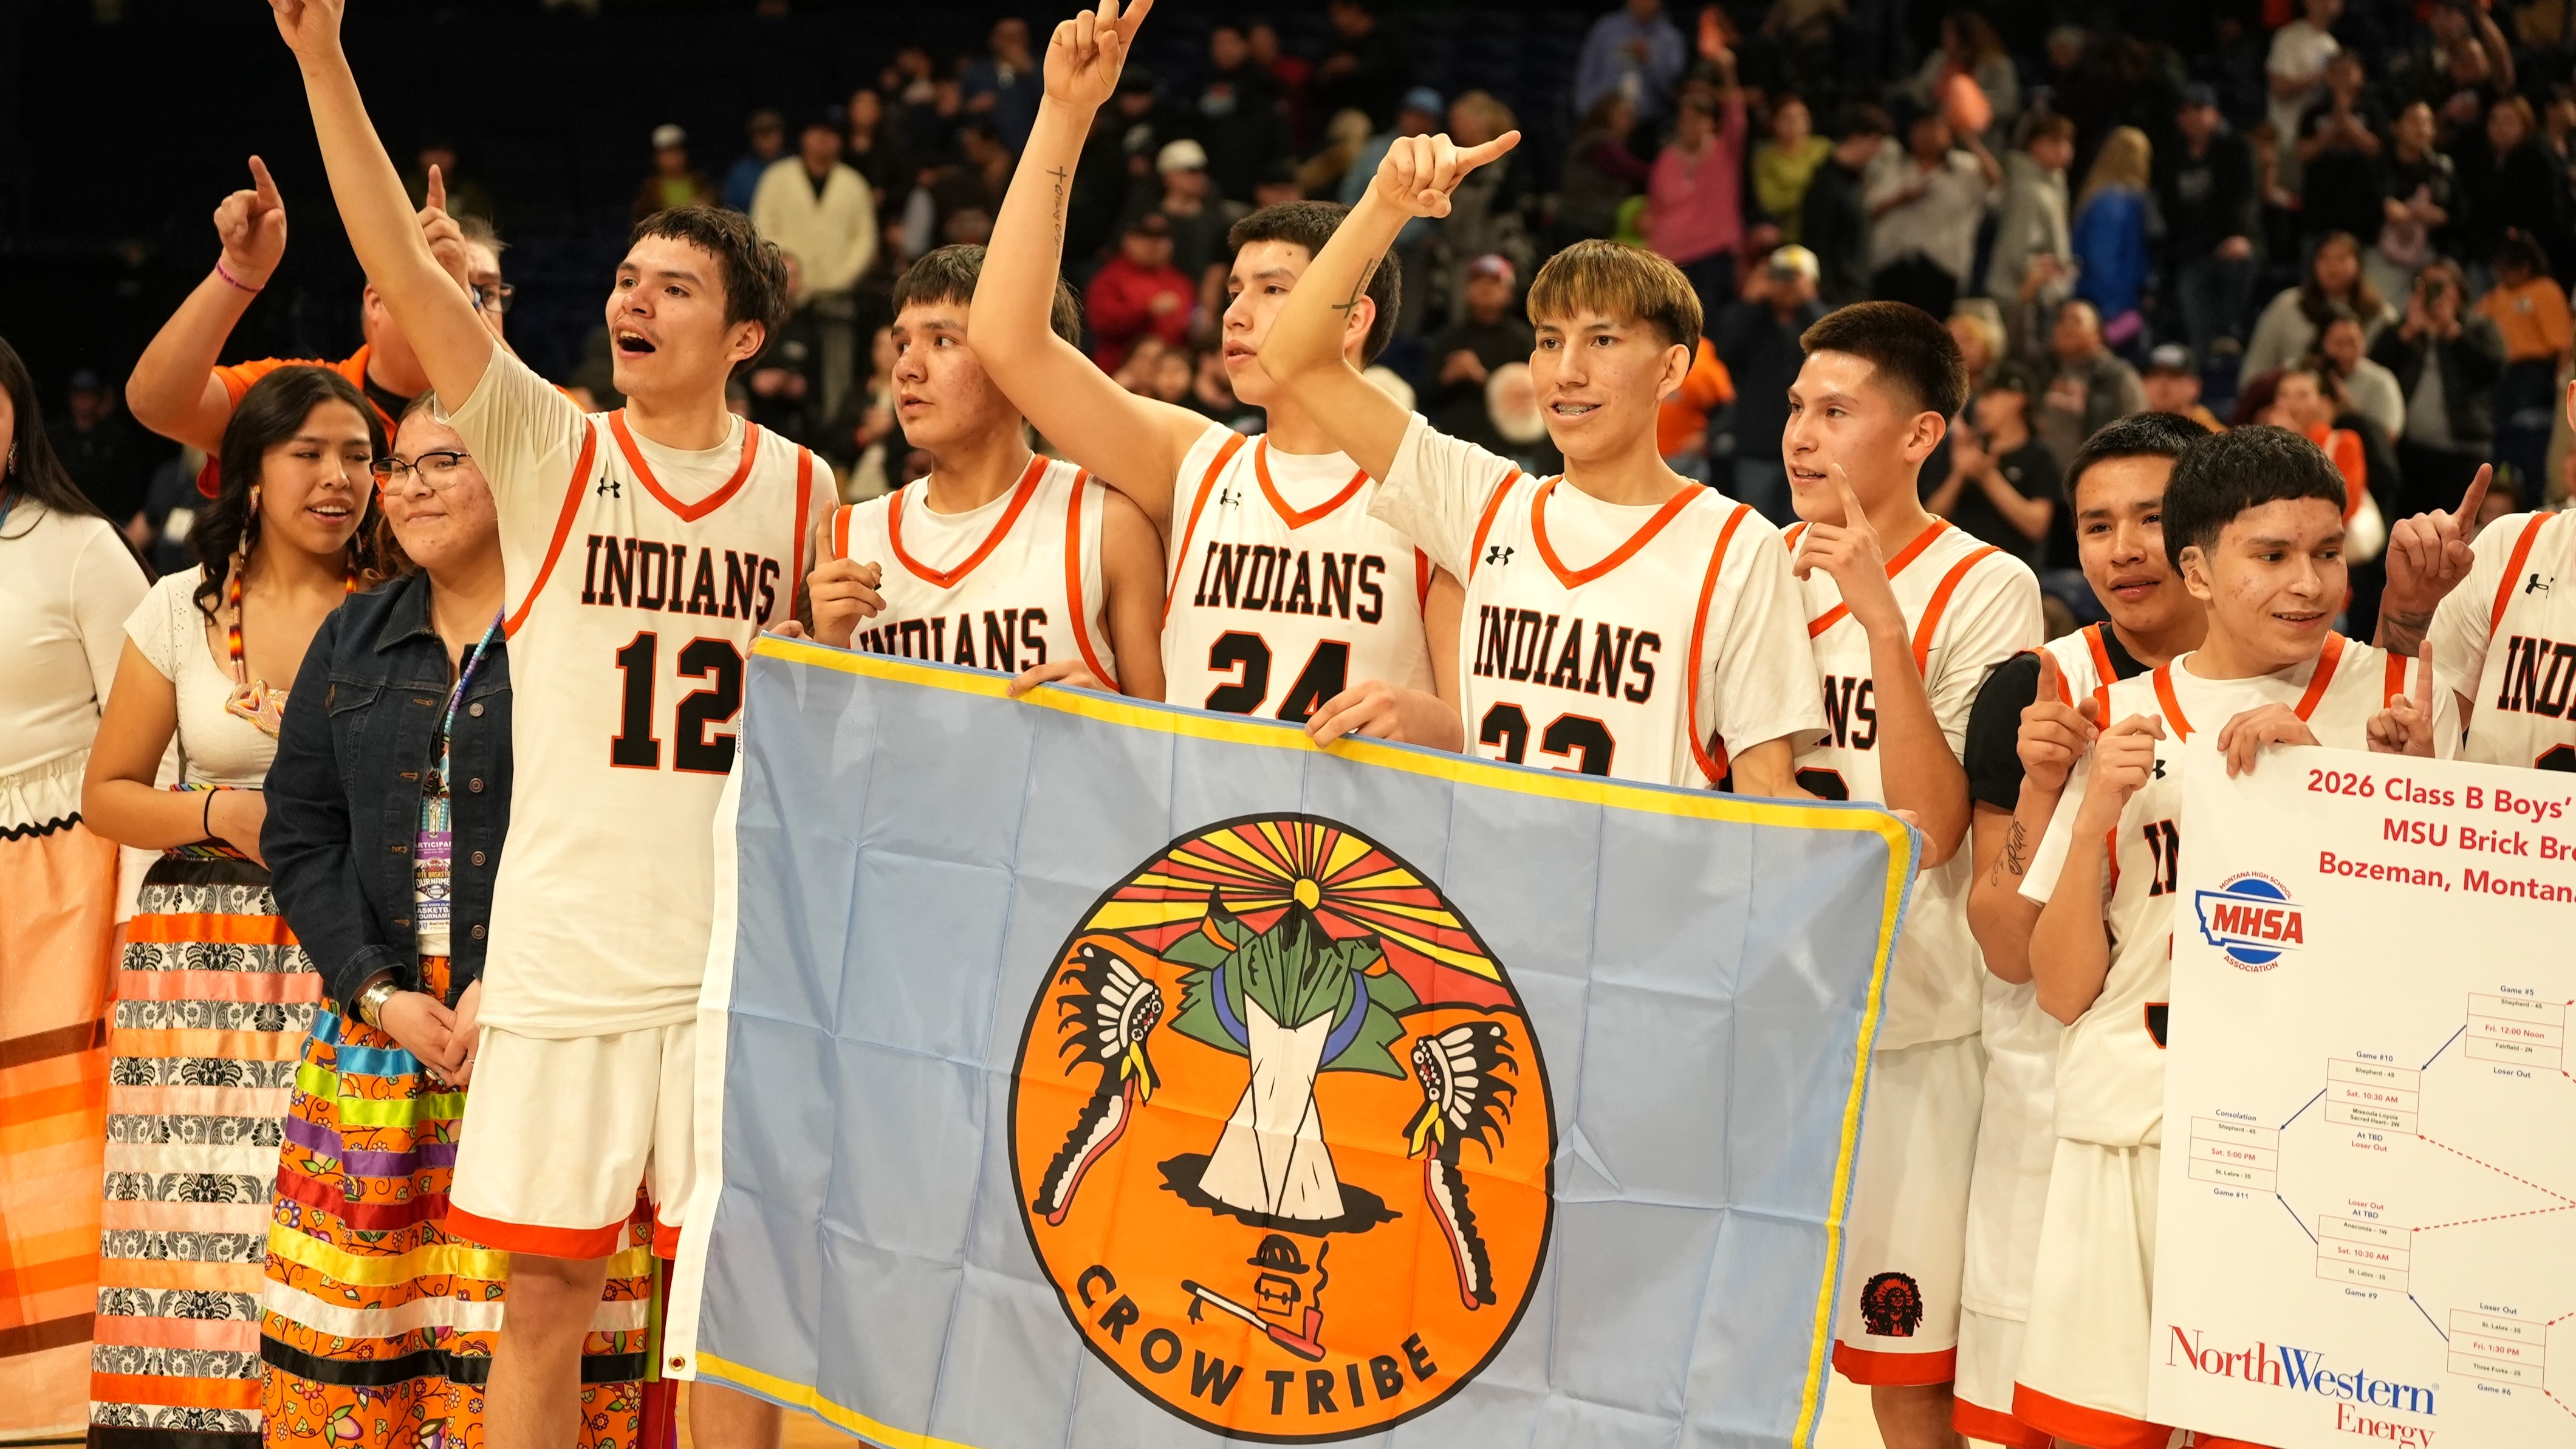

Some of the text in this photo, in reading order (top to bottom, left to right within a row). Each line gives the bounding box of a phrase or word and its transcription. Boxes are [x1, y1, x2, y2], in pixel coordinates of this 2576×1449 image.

[581, 533, 780, 626] INDIANS
[1193, 540, 1386, 625] INDIANS
[1473, 604, 1662, 705] INDIANS
[1205, 629, 1351, 723] 24
[610, 631, 744, 775] 12
[2308, 769, 2374, 797] 2026
[2385, 778, 2454, 806] Class
[2466, 786, 2484, 809] B
[2383, 818, 2448, 846] MSU
[2459, 826, 2529, 857] Brick
[2319, 851, 2576, 903] Bozeman, Montan
[2219, 871, 2292, 900] MONTANA HIGH SCHOOL
[2213, 903, 2303, 944] MHSA
[2224, 955, 2278, 973] ASSOCIATION
[2500, 985, 2522, 994] Game
[2501, 998, 2530, 1008] Shepherd
[2500, 1026, 2521, 1035] 12:00
[2523, 1029, 2544, 1039] Noon
[2356, 1050, 2377, 1060] Game
[2355, 1067, 2382, 1077] Shepherd
[2493, 1066, 2531, 1078] Loser Out
[2346, 1089, 2360, 1098] Sat.
[2363, 1092, 2383, 1101] 10:30
[2216, 1109, 2256, 1122] Consolation
[2350, 1114, 2369, 1123] Sacred
[2352, 1108, 2398, 1121] Missoula Loyola
[2218, 1123, 2244, 1132] Shepherd
[2368, 1133, 2383, 1142] TBD
[2352, 1140, 2387, 1152] Loser Out
[2211, 1148, 2225, 1156] Sat.
[2227, 1150, 2242, 1159] 5:00
[2224, 1170, 2239, 1178] Labre
[2213, 1188, 2234, 1197] Game
[2348, 1198, 2384, 1210] Loser Out
[2363, 1210, 2379, 1219] TBD
[2343, 1222, 2372, 1232] Anaconda
[2337, 1246, 2351, 1255] Sat.
[2354, 1249, 2374, 1259] 10:30
[2345, 1287, 2366, 1298] Game
[2480, 1302, 2518, 1315] Loser Out
[1076, 1264, 1437, 1416] CROW TRIBE
[2473, 1341, 2485, 1350] Fri.
[2489, 1345, 2505, 1354] 1:30
[2473, 1363, 2490, 1371] Three
[2492, 1366, 2508, 1375] Forks
[2478, 1383, 2499, 1393] Game
[2335, 1402, 2436, 1449] Energy
